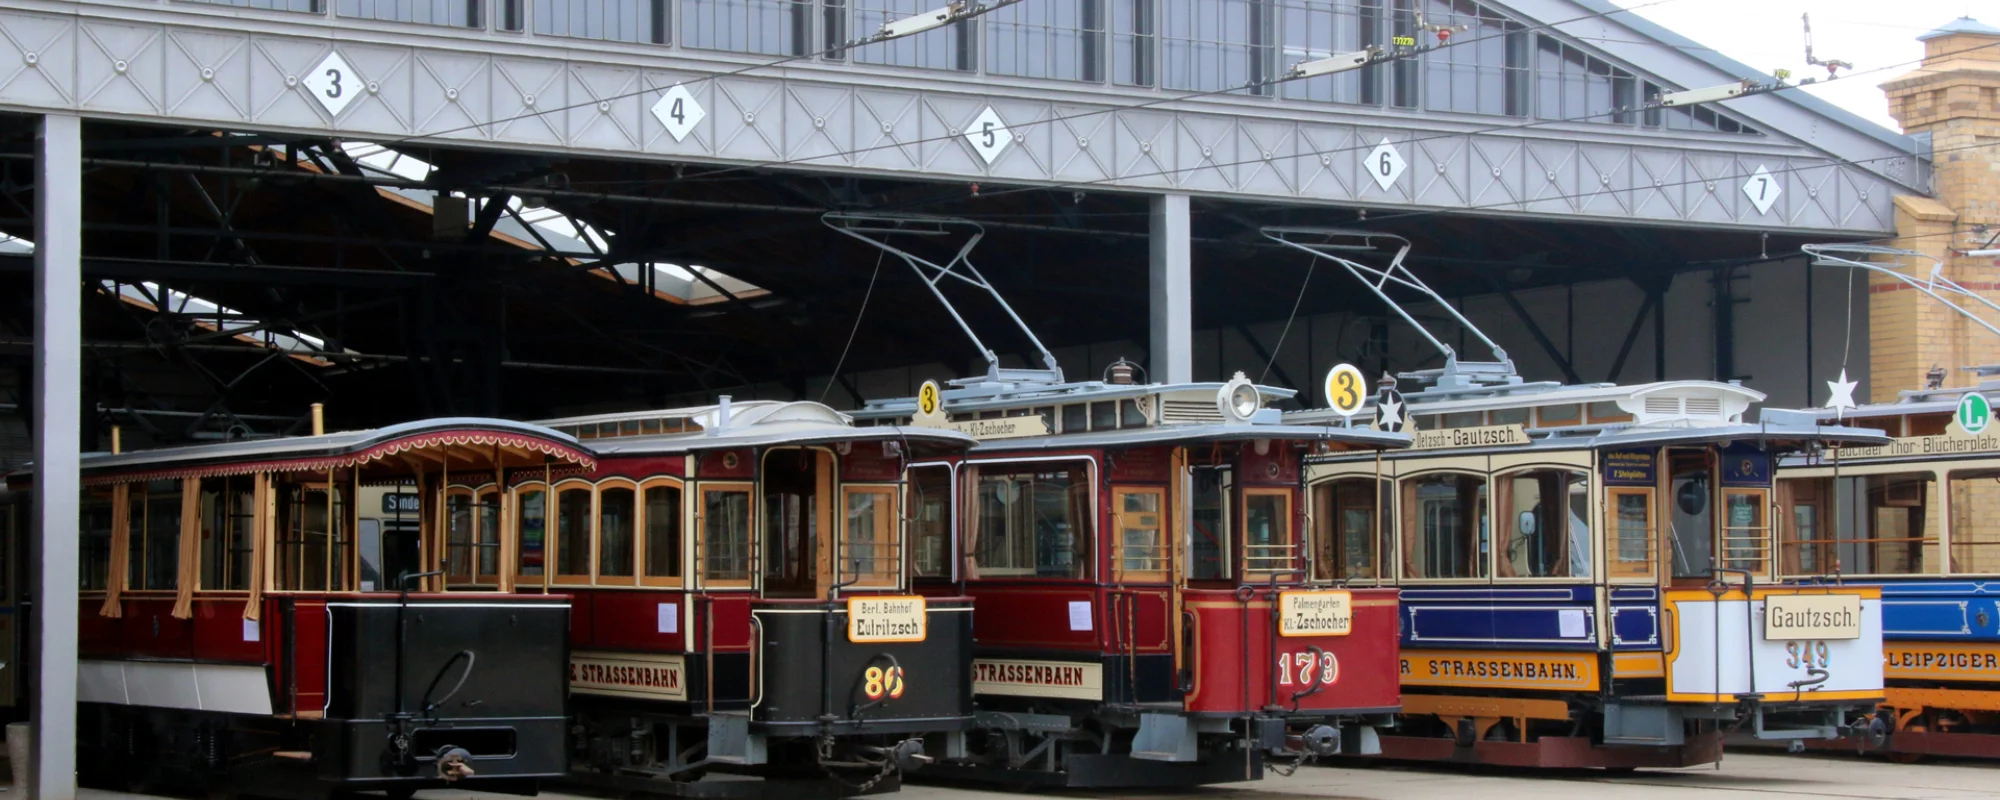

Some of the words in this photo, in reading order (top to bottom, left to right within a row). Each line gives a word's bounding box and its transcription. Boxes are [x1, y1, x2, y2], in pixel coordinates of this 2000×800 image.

[326, 69, 342, 98] 3
[671, 98, 685, 125] 4
[981, 122, 995, 148] 5
[1380, 152, 1391, 176] 6
[1757, 178, 1768, 200] 7
[923, 385, 935, 414] 3
[1337, 371, 1358, 410] 3
[1963, 399, 1983, 428] L
[884, 602, 913, 614] Bahnhof
[1293, 597, 1340, 613] Palmengarten
[1772, 606, 1856, 628] Gautzsch.
[1785, 640, 1830, 669] 349
[1888, 652, 1999, 670] LEIPZIGER
[581, 663, 678, 688] STRASSENBAHN
[972, 663, 1083, 686] STRASSENBAHN
[1279, 651, 1340, 685] 179
[864, 665, 904, 699] 86
